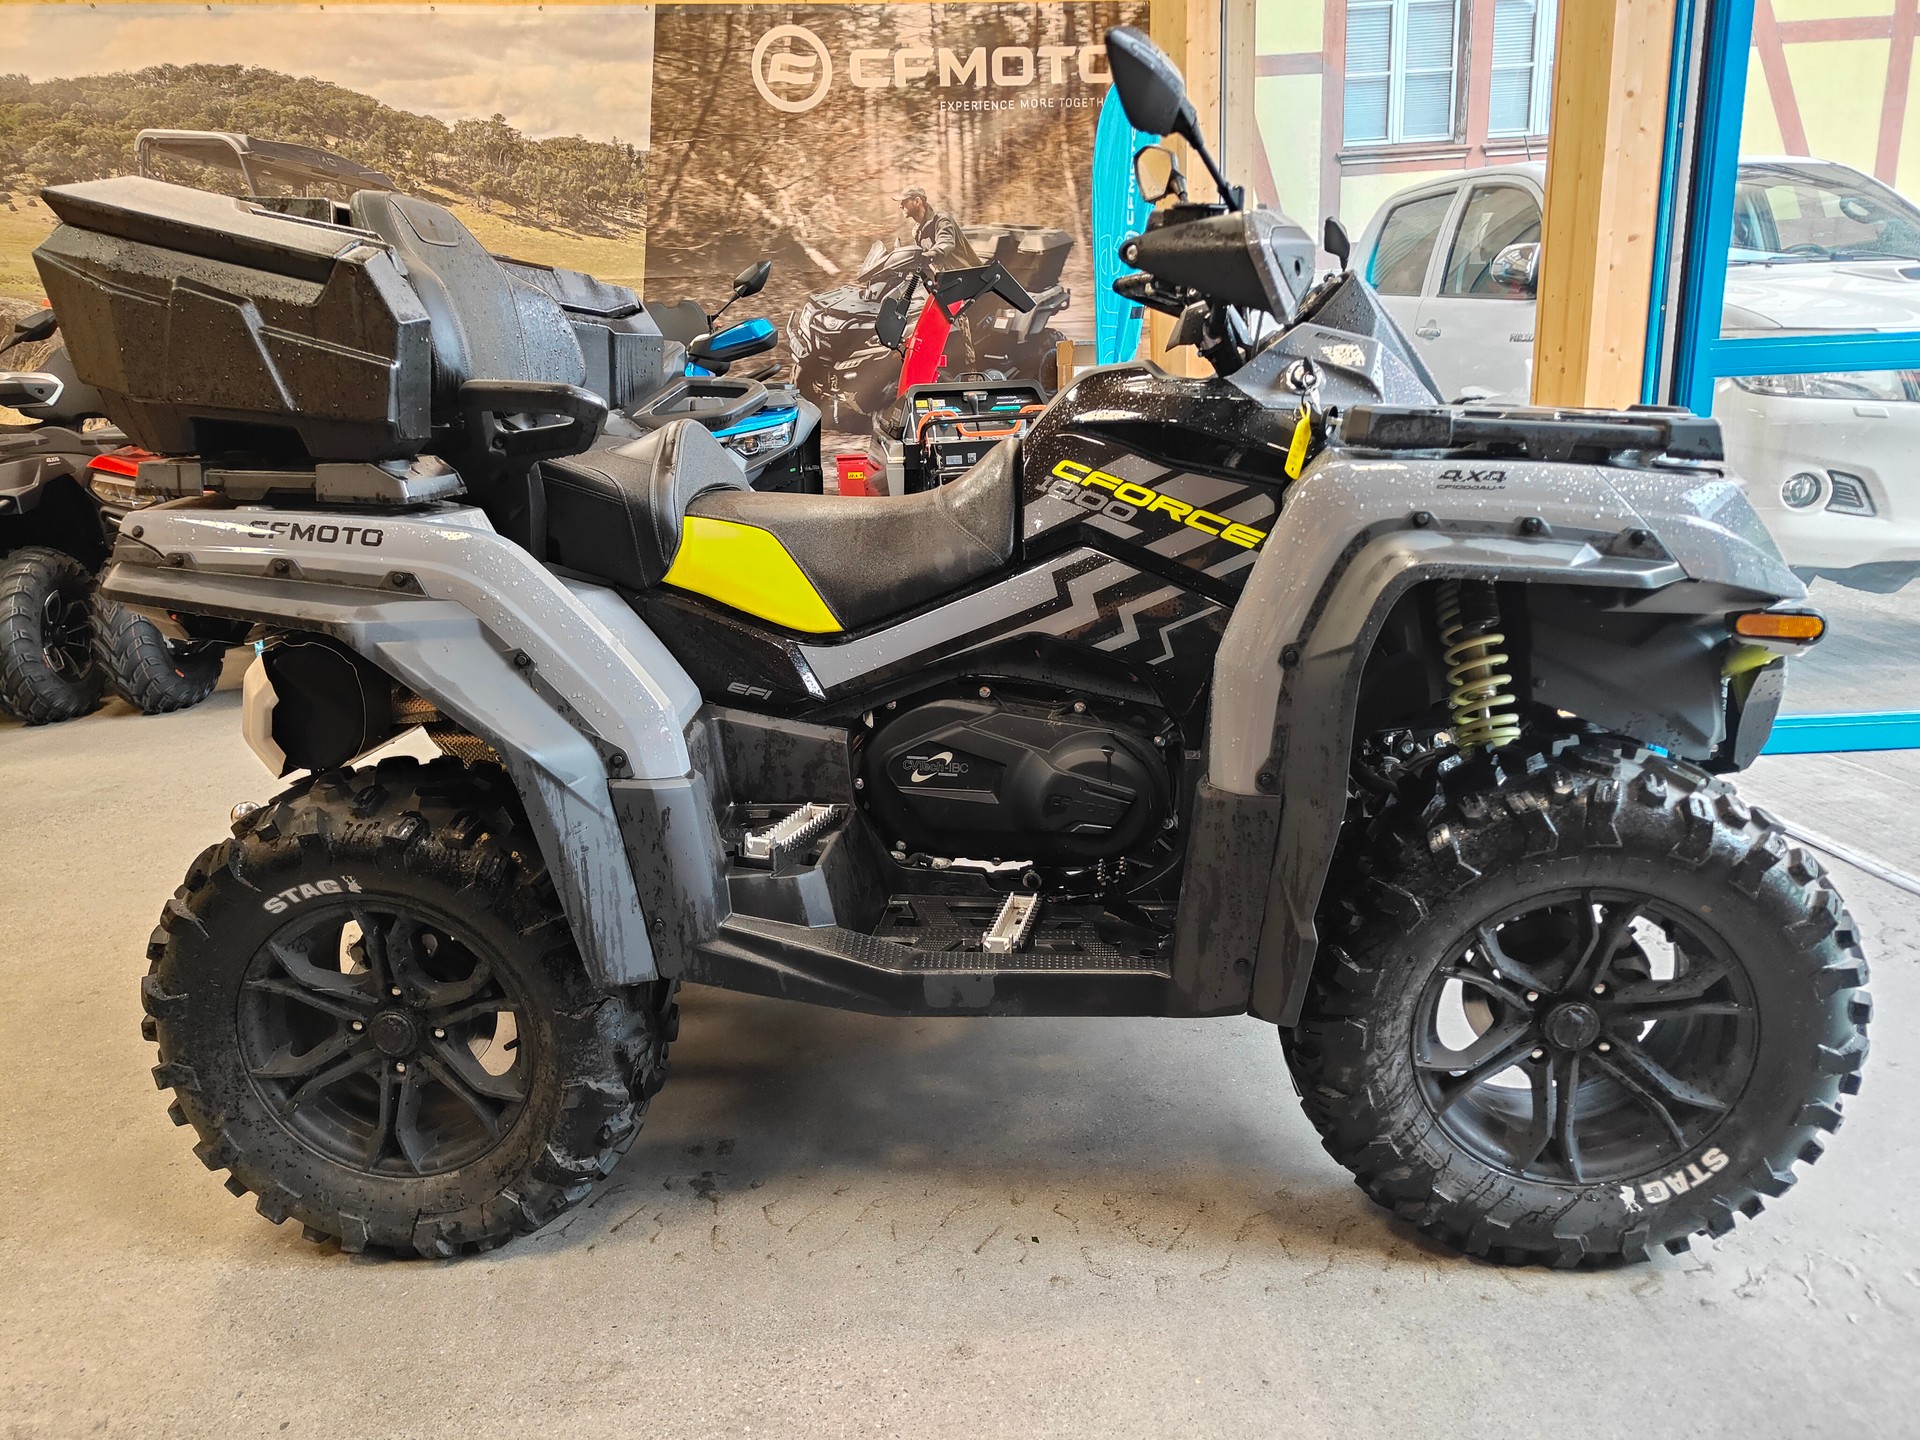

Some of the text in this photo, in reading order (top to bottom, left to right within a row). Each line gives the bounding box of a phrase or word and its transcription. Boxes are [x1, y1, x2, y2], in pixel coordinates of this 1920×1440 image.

[849, 44, 1114, 88] CFMOTO
[940, 100, 1015, 111] EXPERIENCE
[1020, 97, 1055, 108] MORE
[1051, 459, 1268, 549] CFORCE
[249, 520, 385, 547] CFMOTO
[726, 681, 774, 700] EFI
[263, 879, 344, 914] STAG
[1641, 1147, 1730, 1204] STAG
